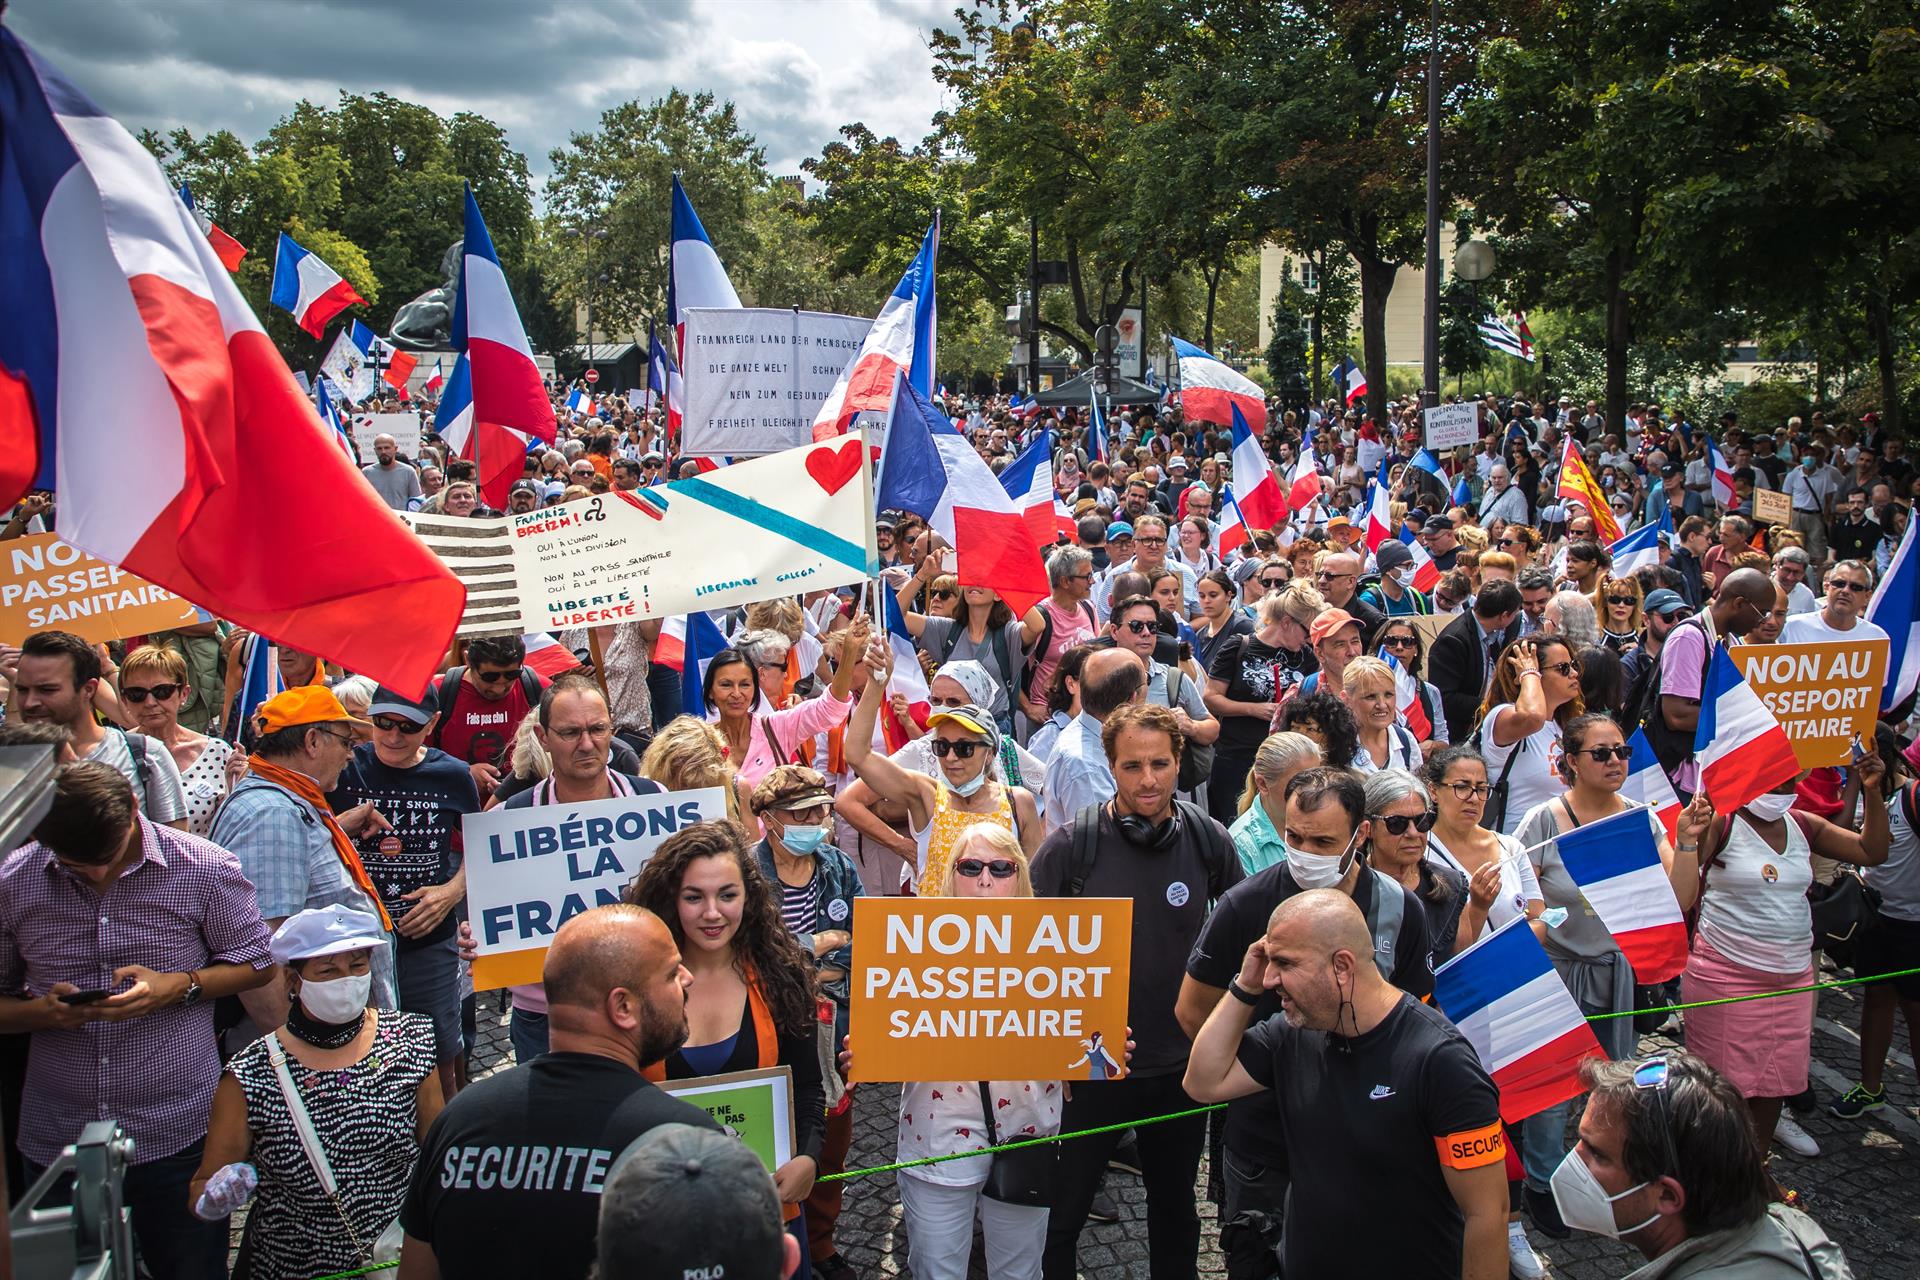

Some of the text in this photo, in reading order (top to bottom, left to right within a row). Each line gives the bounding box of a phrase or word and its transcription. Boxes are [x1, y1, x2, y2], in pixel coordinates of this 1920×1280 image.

[697, 334, 858, 350] FRANKREICH LAND DER MENSCHE
[709, 363, 845, 375] DIE GANZE WELT SCHAU
[730, 391, 751, 400] NEIN
[757, 390, 777, 400] ZUM
[709, 418, 756, 429] FREIHEIT
[537, 543, 554, 553] OUI
[571, 548, 581, 556] LA
[11, 540, 98, 575] NO
[544, 573, 564, 583] NON
[572, 569, 586, 578] AU
[591, 562, 621, 574] PASS
[2, 564, 143, 607] PASSEP
[584, 579, 597, 587] LA
[1745, 651, 1872, 684] NON AU
[1763, 686, 1872, 715] SSEPORT
[387, 799, 401, 809] IT
[406, 800, 439, 809] SNOW
[1888, 814, 1899, 825] YC
[489, 801, 702, 864] LIBÉRONS
[567, 847, 624, 882] LA
[886, 914, 1102, 954] NON AU
[865, 966, 1111, 999] PASSEPORT
[888, 1009, 1083, 1038] SANITAIRE
[1373, 1084, 1391, 1095] NIKE
[717, 1104, 731, 1115] NE
[725, 1113, 745, 1124] PAS
[440, 1146, 612, 1193] SECURITE
[683, 1264, 725, 1280] POLO
